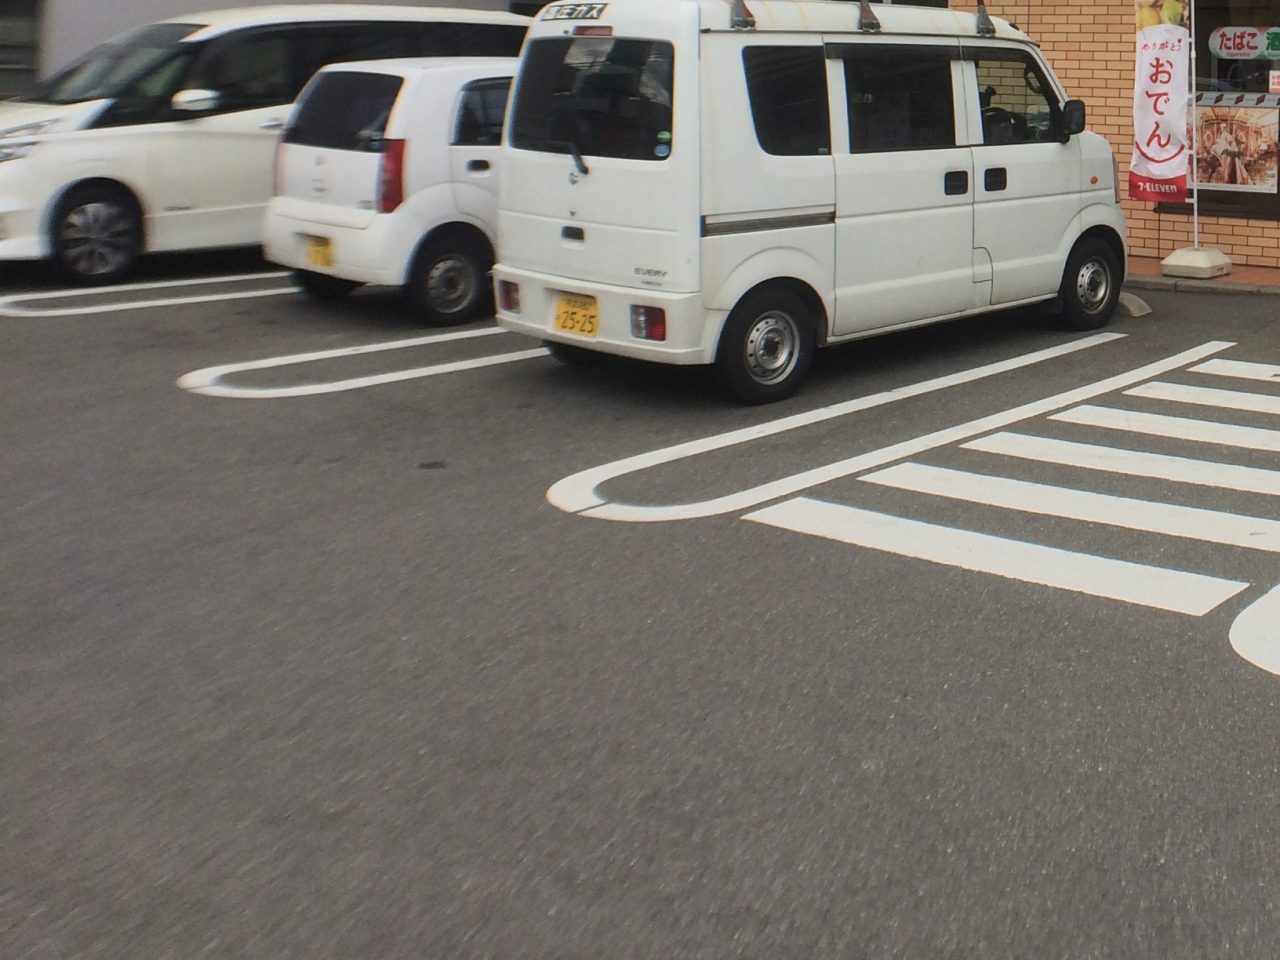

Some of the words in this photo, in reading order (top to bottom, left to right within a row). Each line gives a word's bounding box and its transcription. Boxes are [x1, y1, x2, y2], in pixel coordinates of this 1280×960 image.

[1142, 41, 1182, 52] ありがとう
[1219, 31, 1259, 51] たばこ
[1145, 57, 1174, 149] おでん
[560, 310, 597, 334] 25-25
